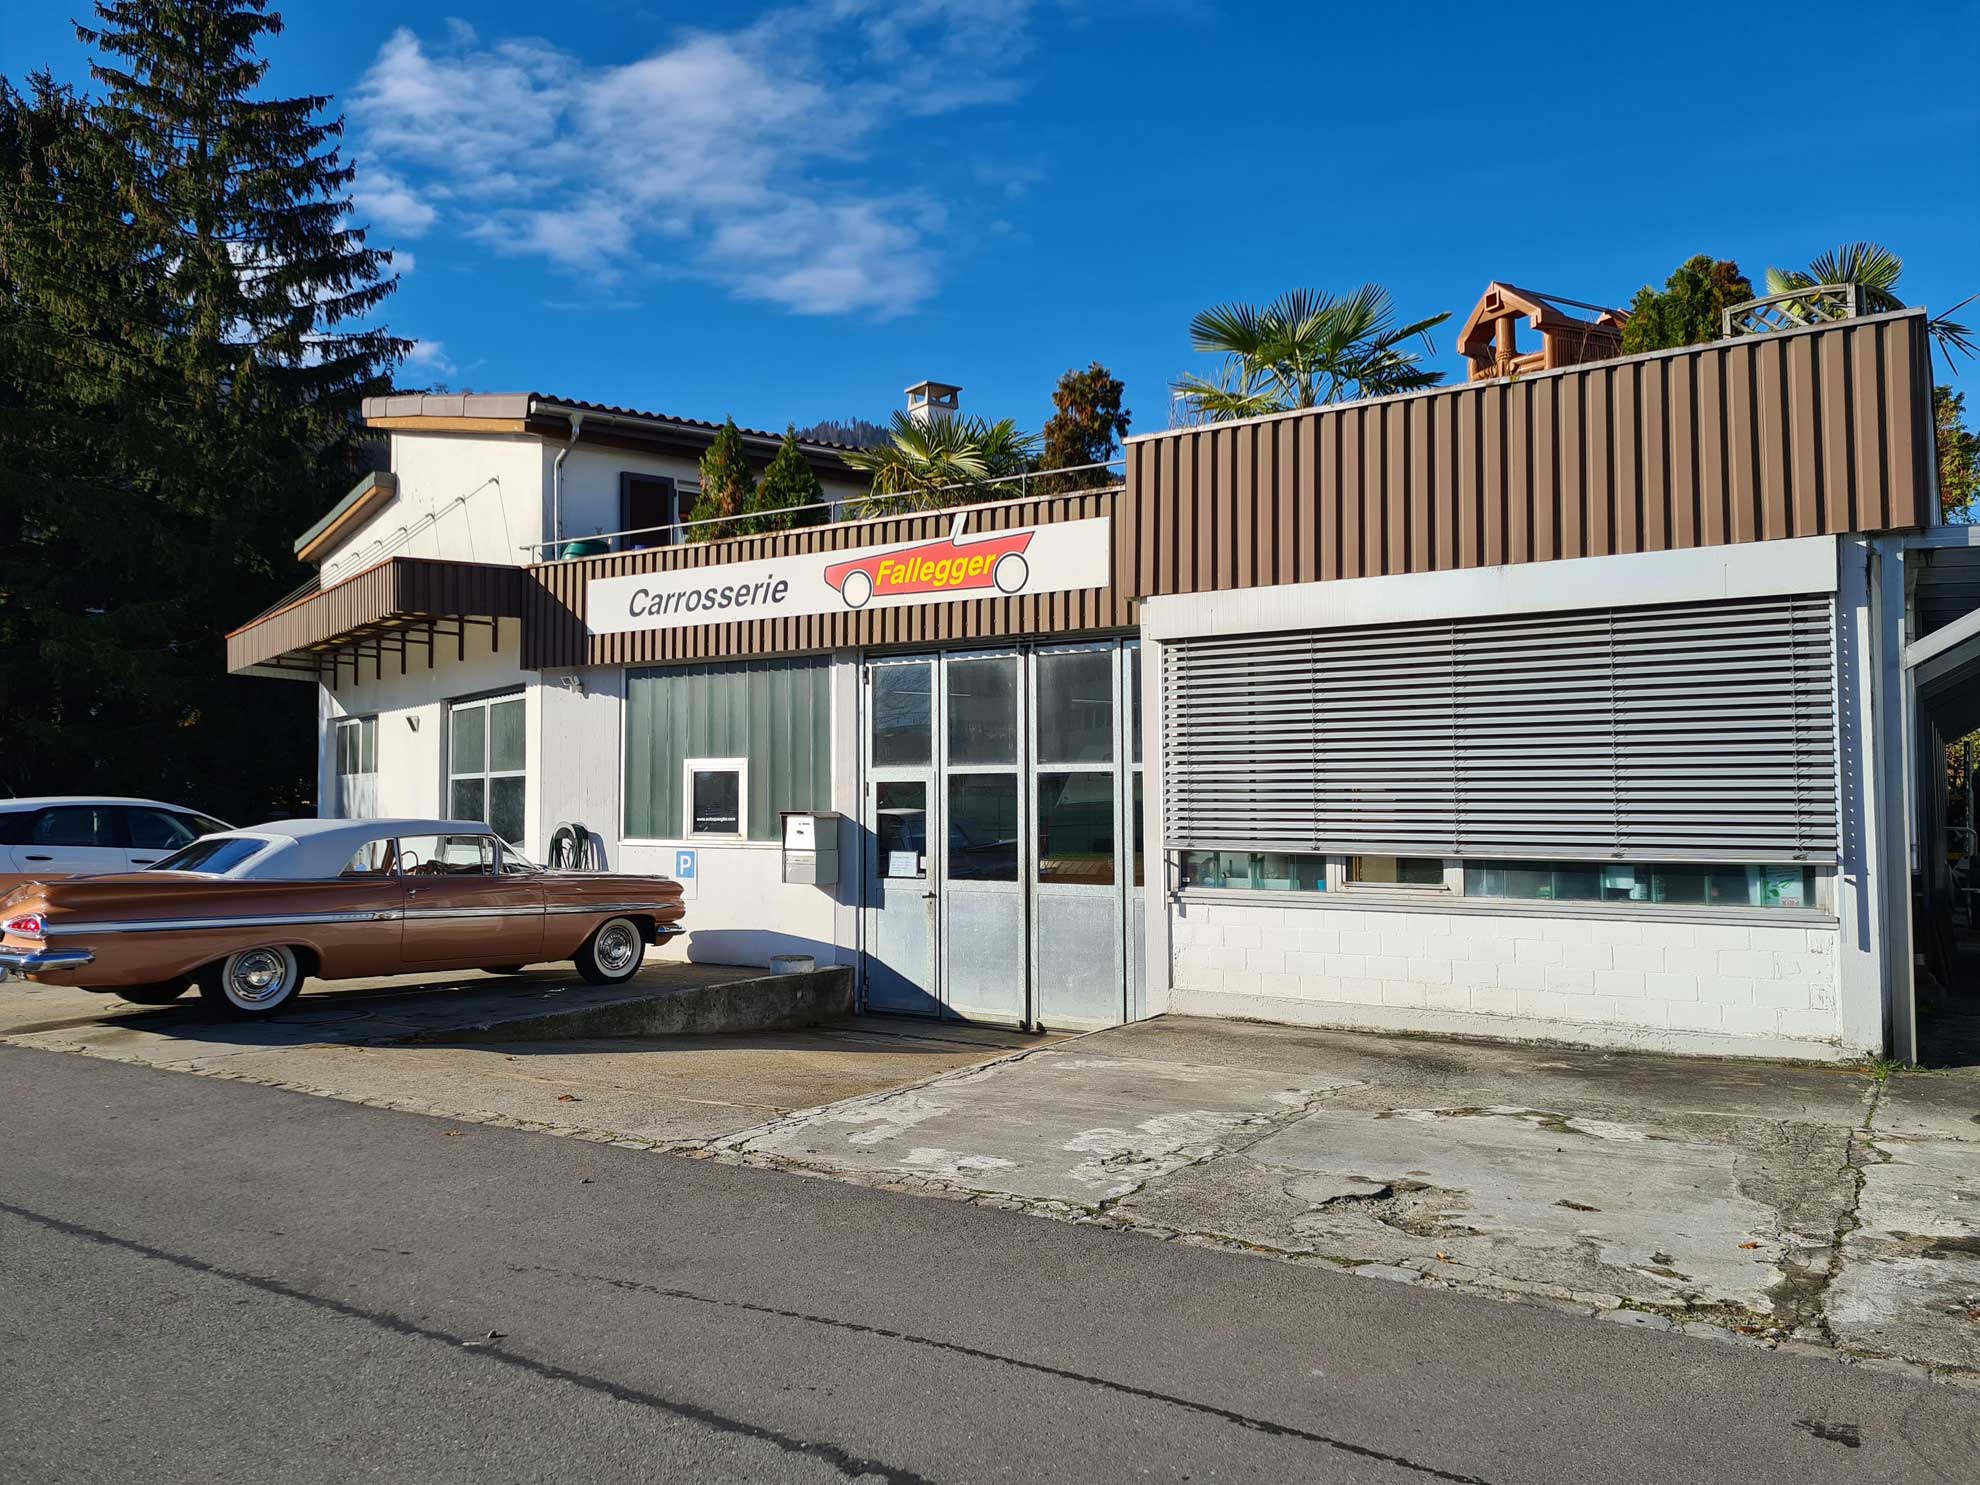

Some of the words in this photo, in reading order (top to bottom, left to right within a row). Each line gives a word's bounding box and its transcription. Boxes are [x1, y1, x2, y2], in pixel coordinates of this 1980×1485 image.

[629, 574, 789, 617] Carrosserie
[876, 553, 997, 587] Fallegger
[680, 855, 692, 875] P
